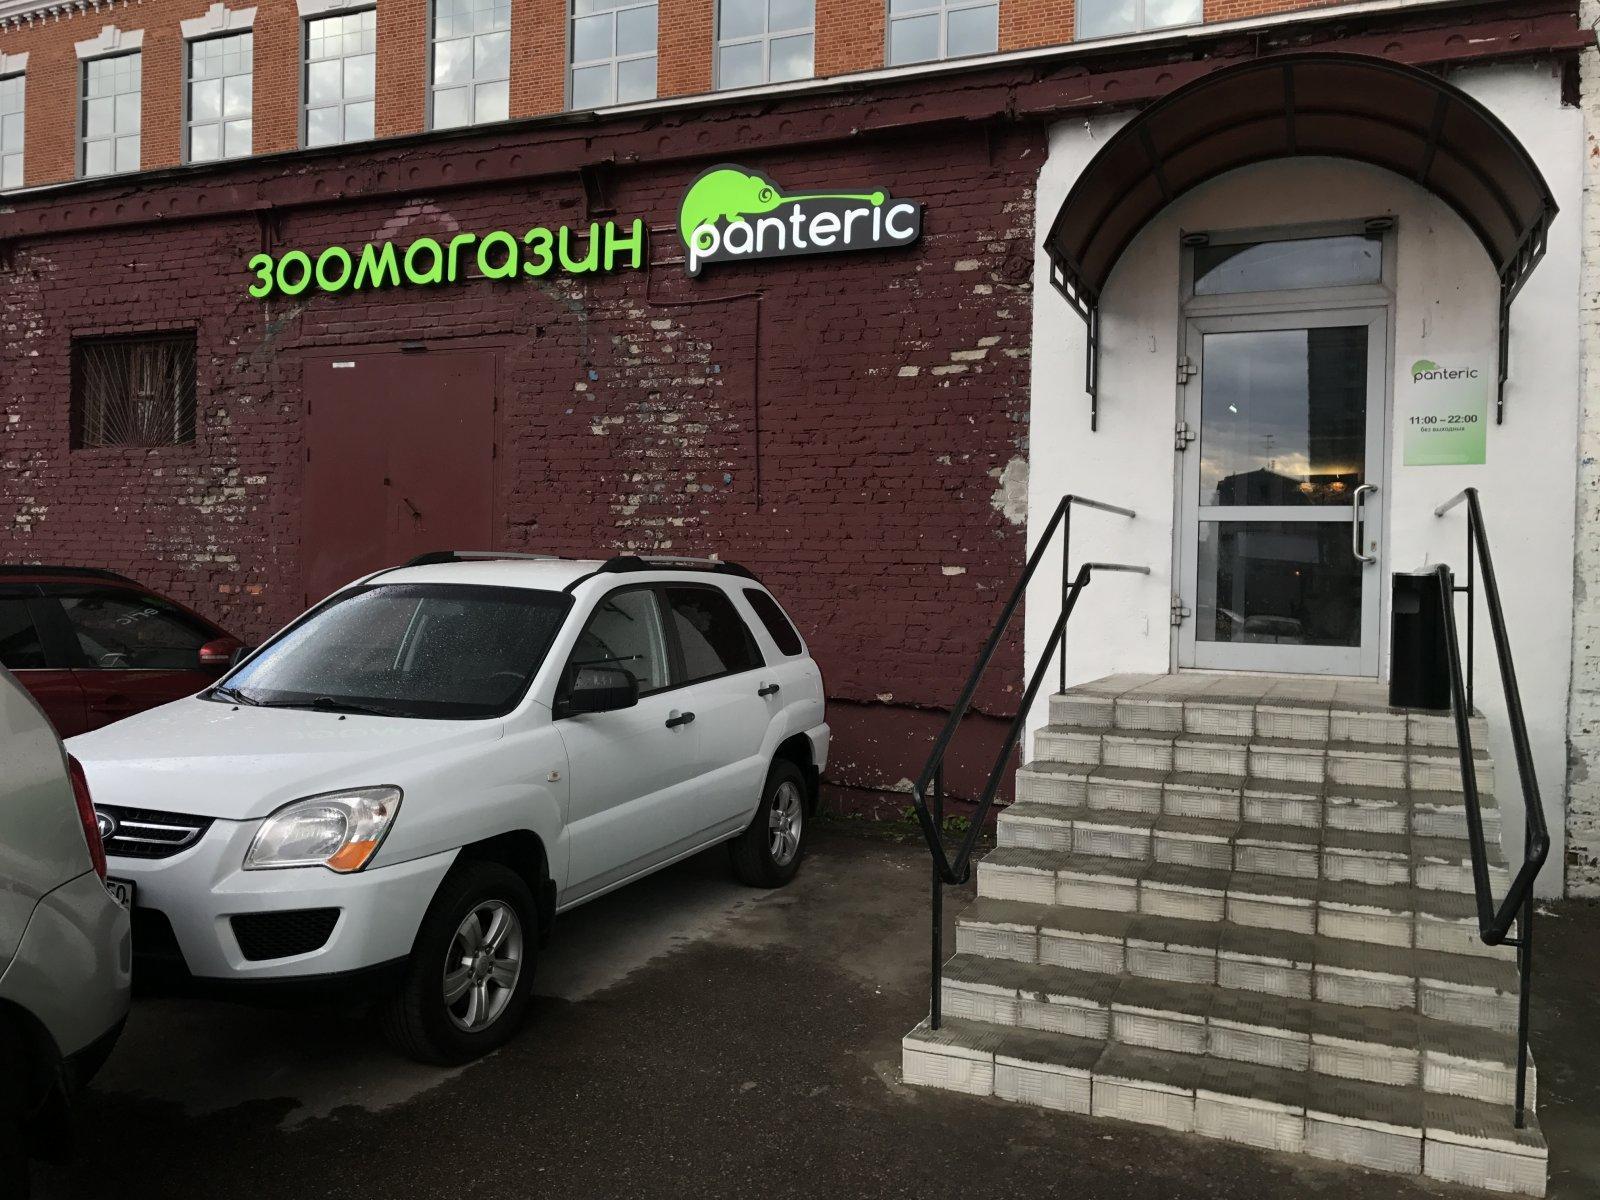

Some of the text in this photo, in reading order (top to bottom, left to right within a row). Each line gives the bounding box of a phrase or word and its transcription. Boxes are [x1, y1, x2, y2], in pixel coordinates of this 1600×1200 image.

[248, 218, 643, 298] зоомагазин
[689, 200, 915, 272] panteric
[1413, 367, 1479, 384] panteric
[1409, 415, 1437, 425] 11:00
[1447, 414, 1478, 424] 22:00
